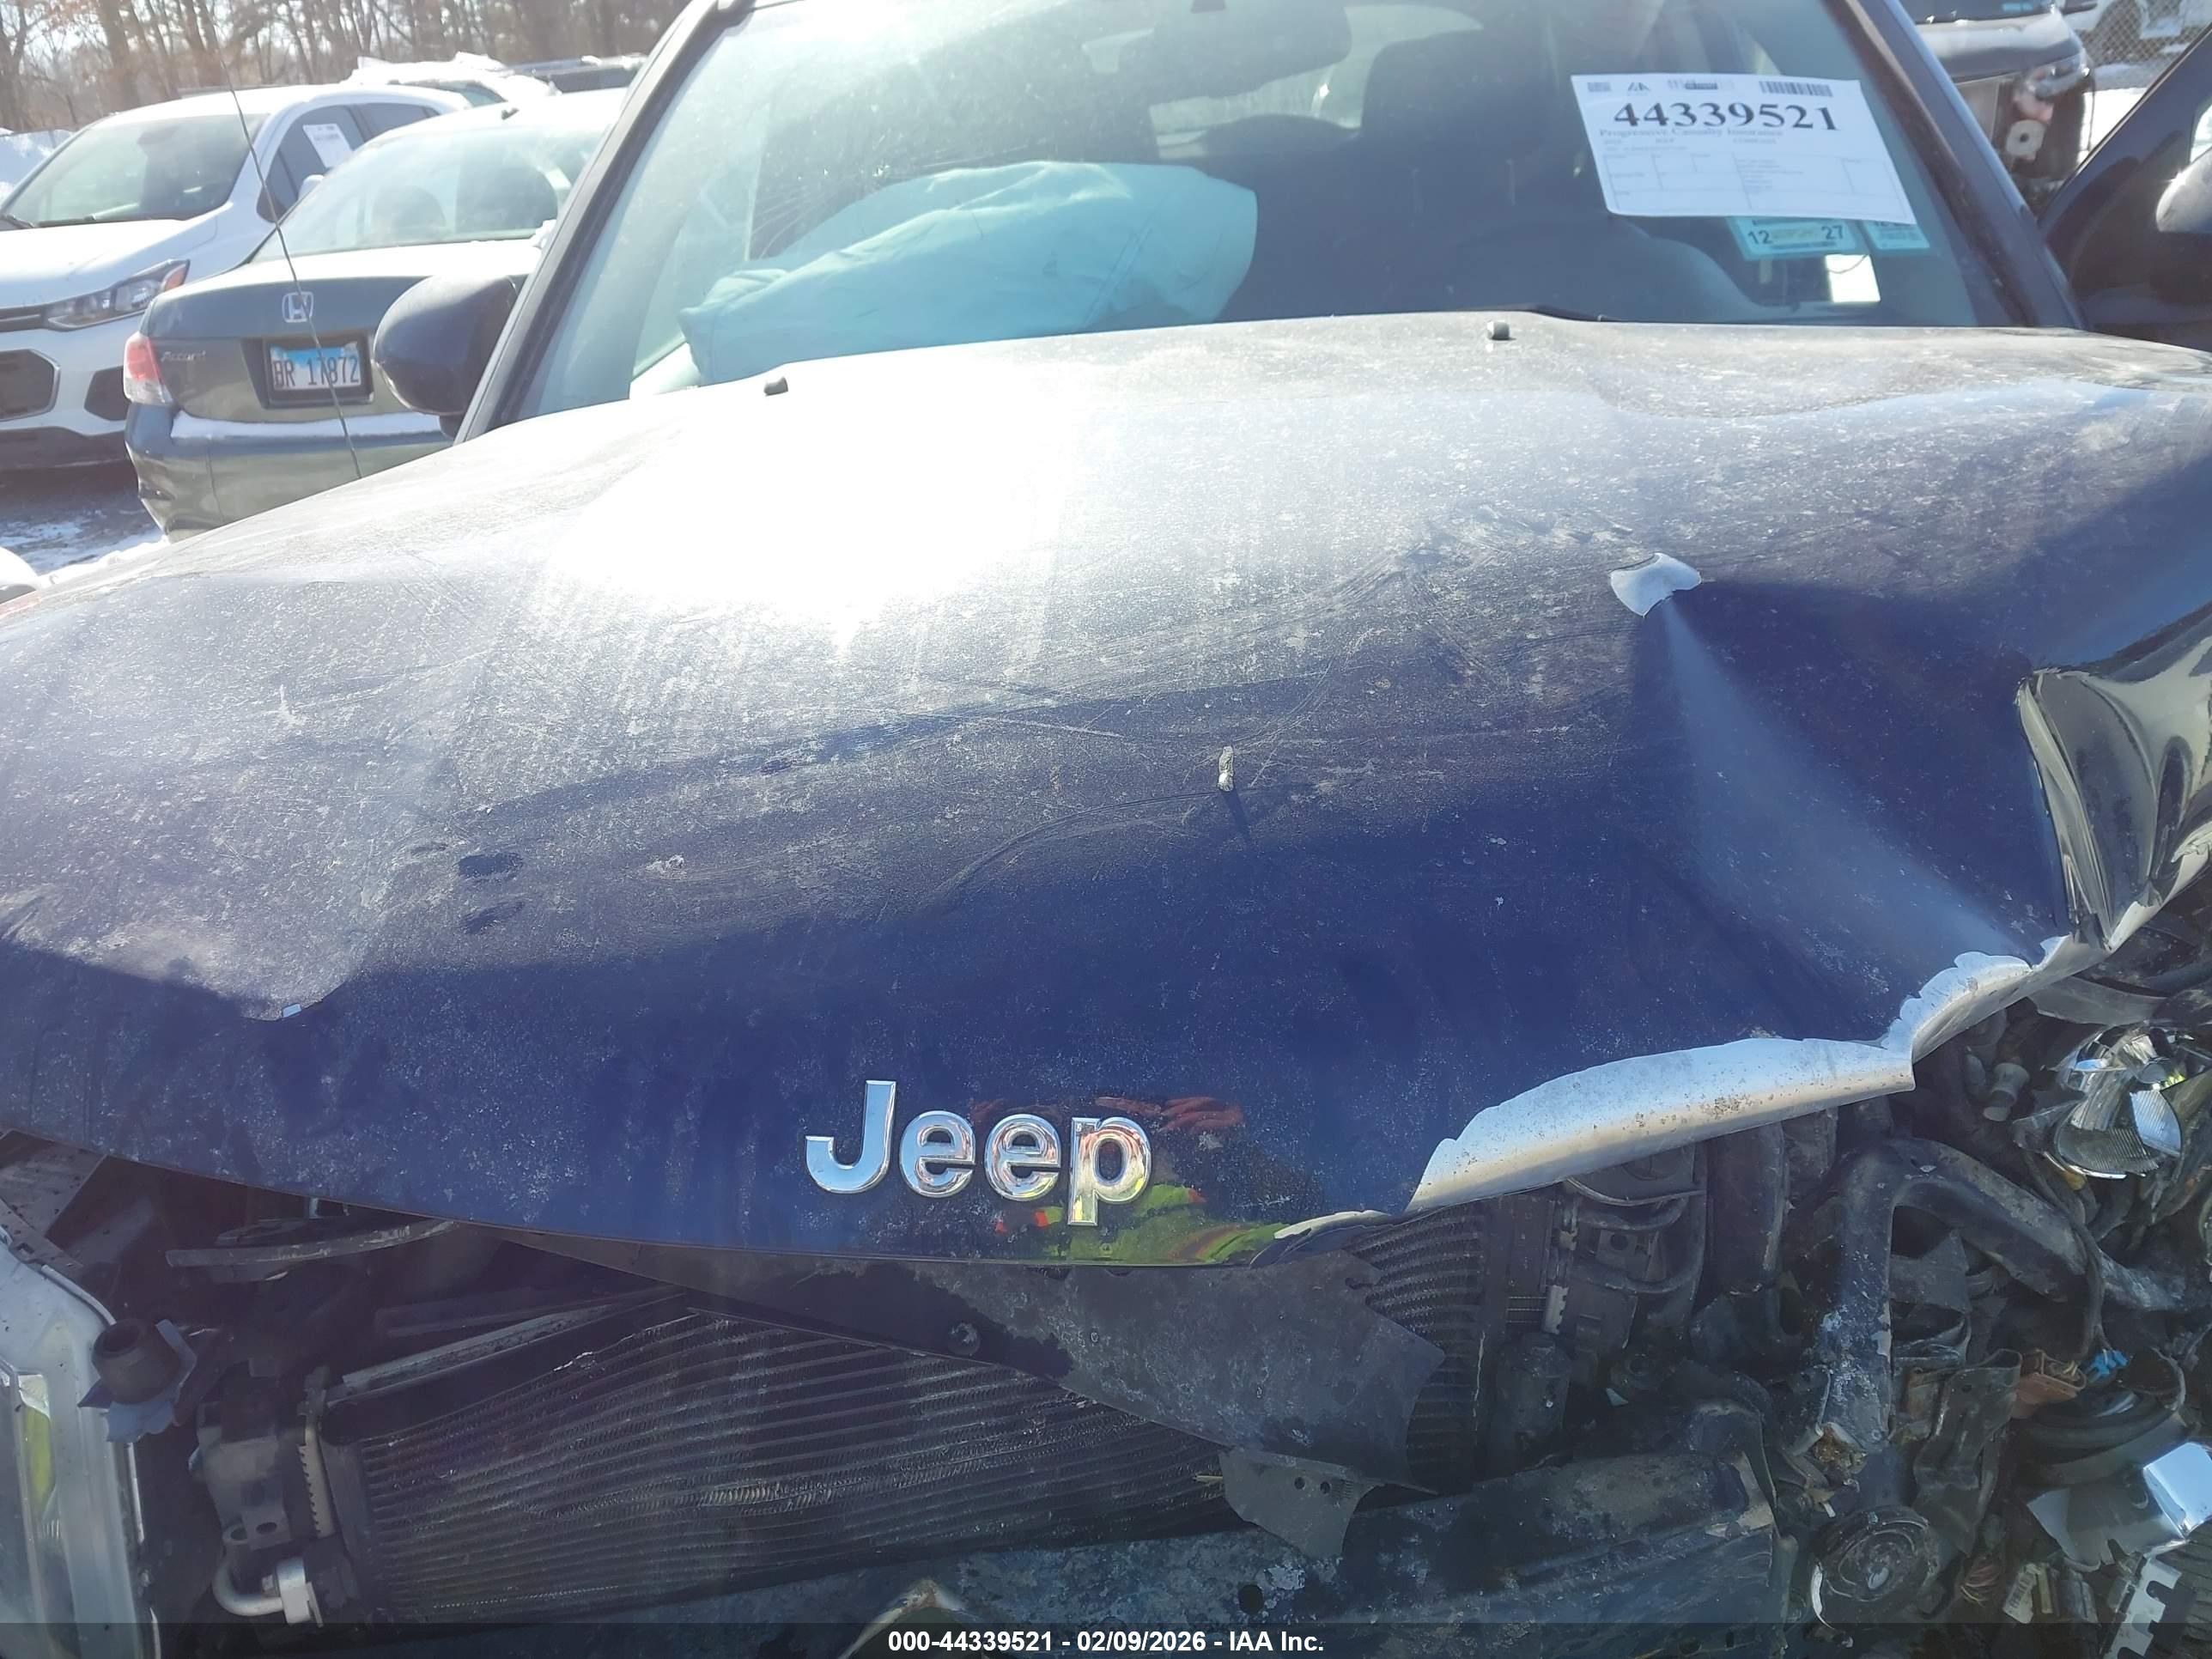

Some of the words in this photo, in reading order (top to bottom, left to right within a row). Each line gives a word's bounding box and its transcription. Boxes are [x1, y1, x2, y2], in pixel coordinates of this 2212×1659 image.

[1613, 102, 1839, 131] 44339521
[1747, 229, 1773, 245] 12
[1820, 225, 1844, 240] 27
[307, 356, 359, 386] 17872
[805, 1079, 1152, 1226] Jeep
